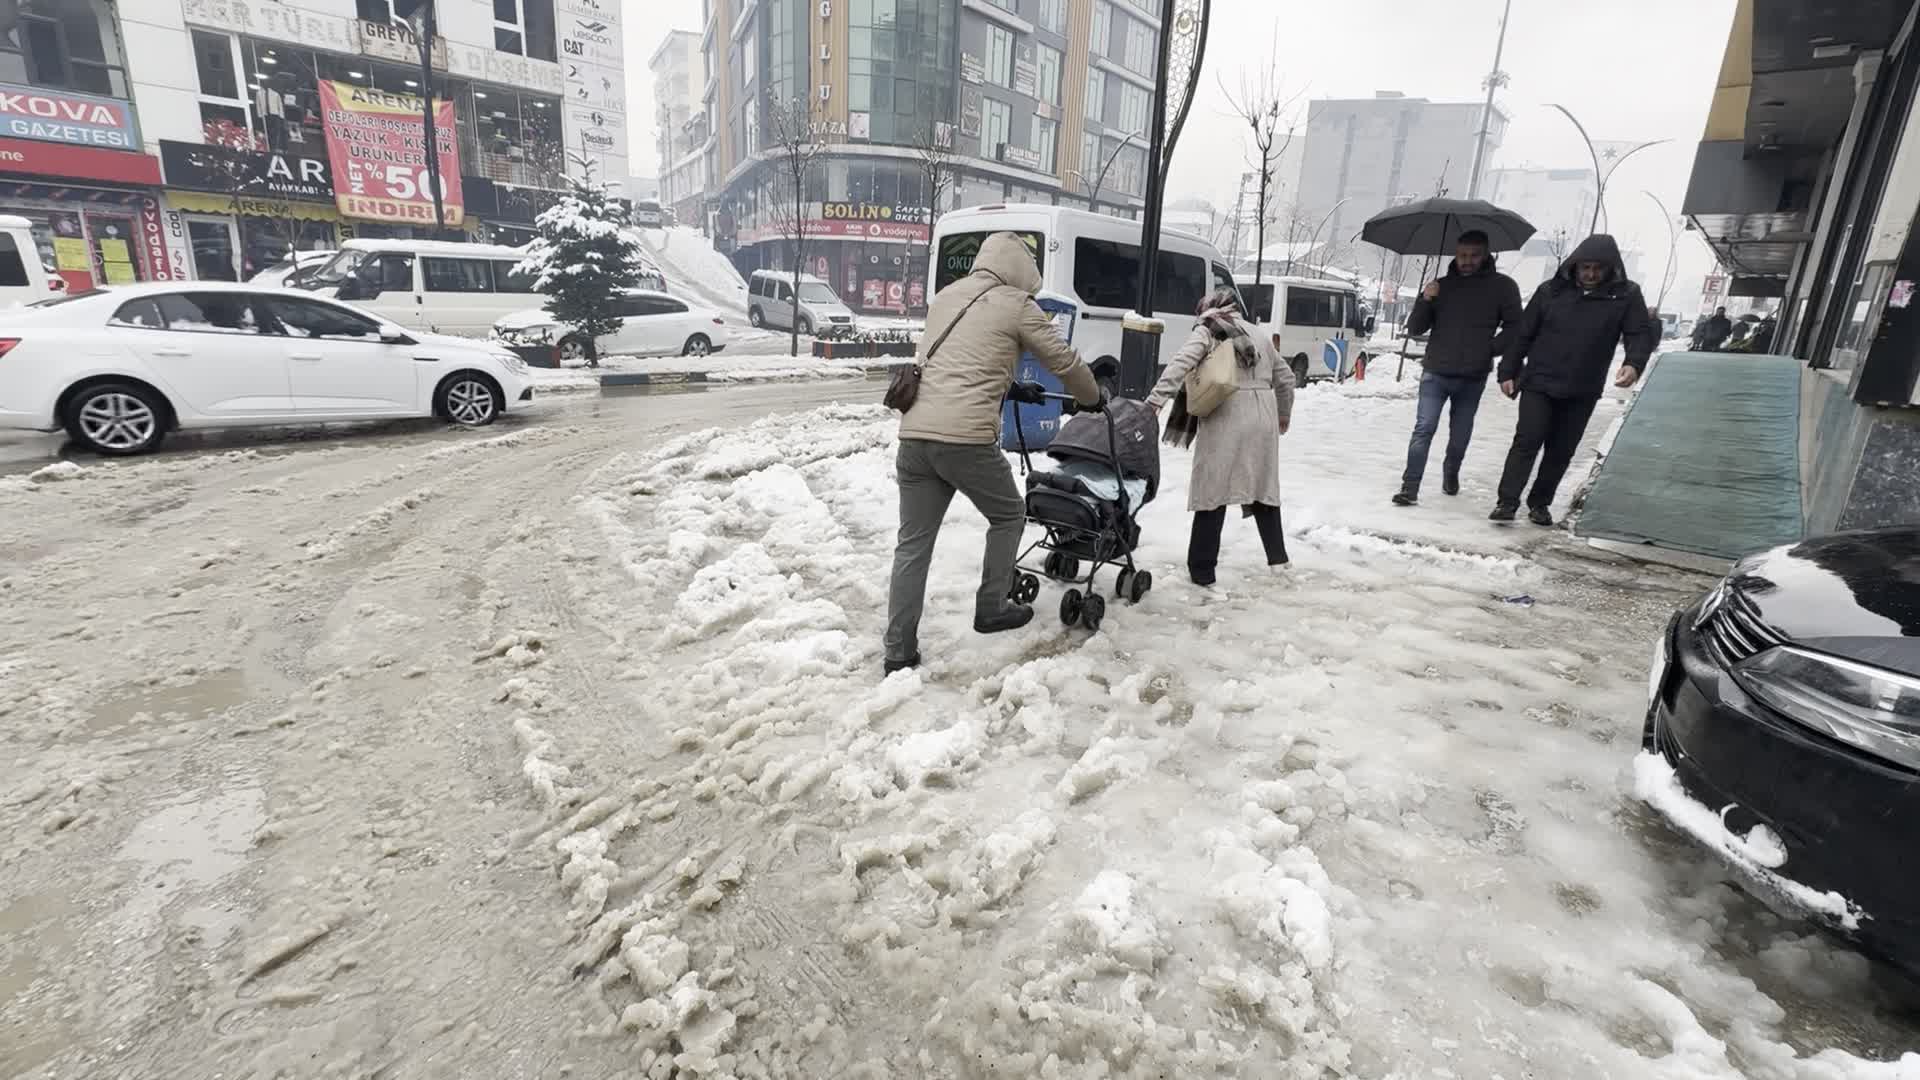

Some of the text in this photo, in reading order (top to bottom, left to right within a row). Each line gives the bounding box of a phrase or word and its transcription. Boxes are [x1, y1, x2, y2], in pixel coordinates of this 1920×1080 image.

[563, 38, 585, 56] CAT
[0, 92, 118, 126] KOVA
[351, 88, 427, 112] ARENA
[332, 126, 388, 146] YAZLIK
[347, 160, 364, 194] NET
[228, 199, 293, 215] ARENA
